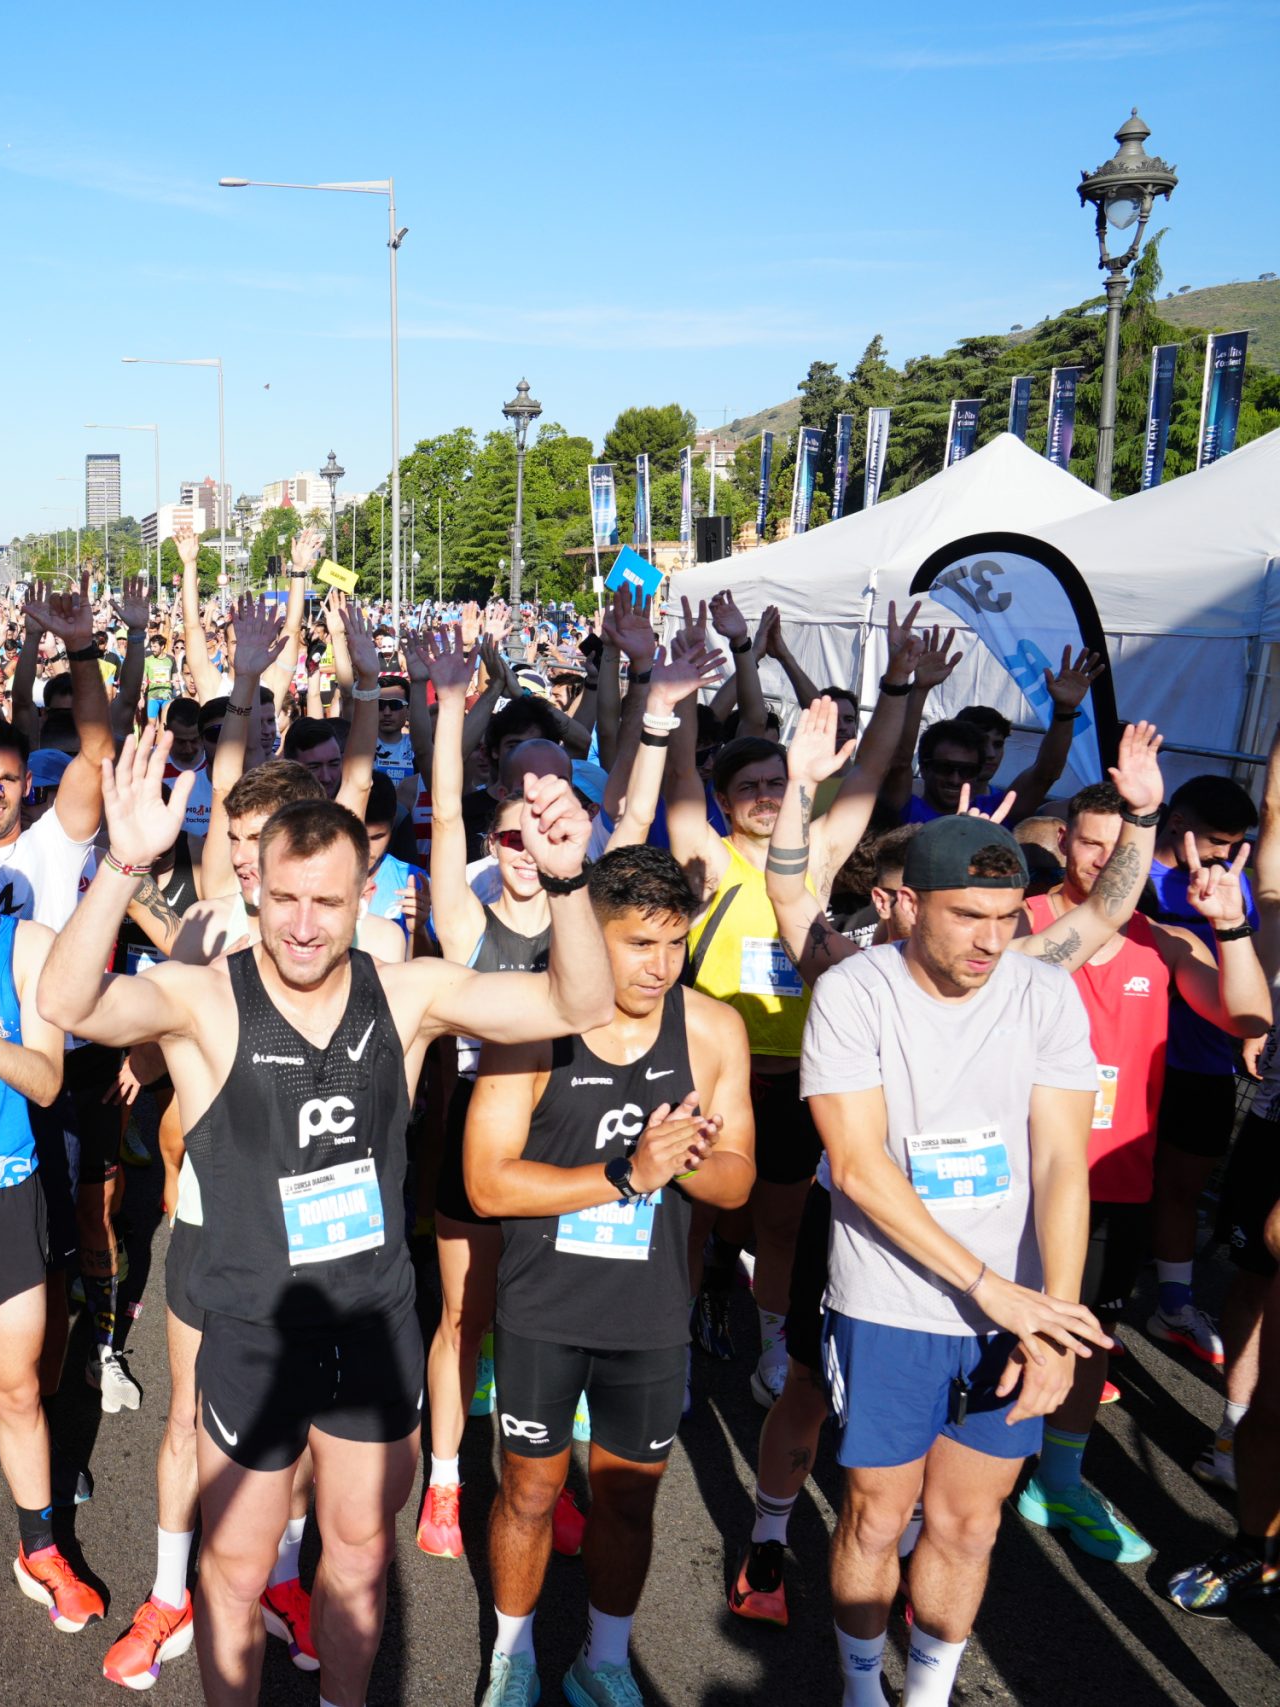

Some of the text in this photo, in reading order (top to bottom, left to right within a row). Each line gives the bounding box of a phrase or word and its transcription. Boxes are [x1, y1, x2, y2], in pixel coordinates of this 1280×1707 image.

[261, 1054, 305, 1066] LIFEPRO
[334, 1135, 356, 1145] team
[935, 1153, 988, 1180] ENRIC
[293, 1180, 311, 1190] CURSA
[297, 1187, 369, 1228] ROMAIN
